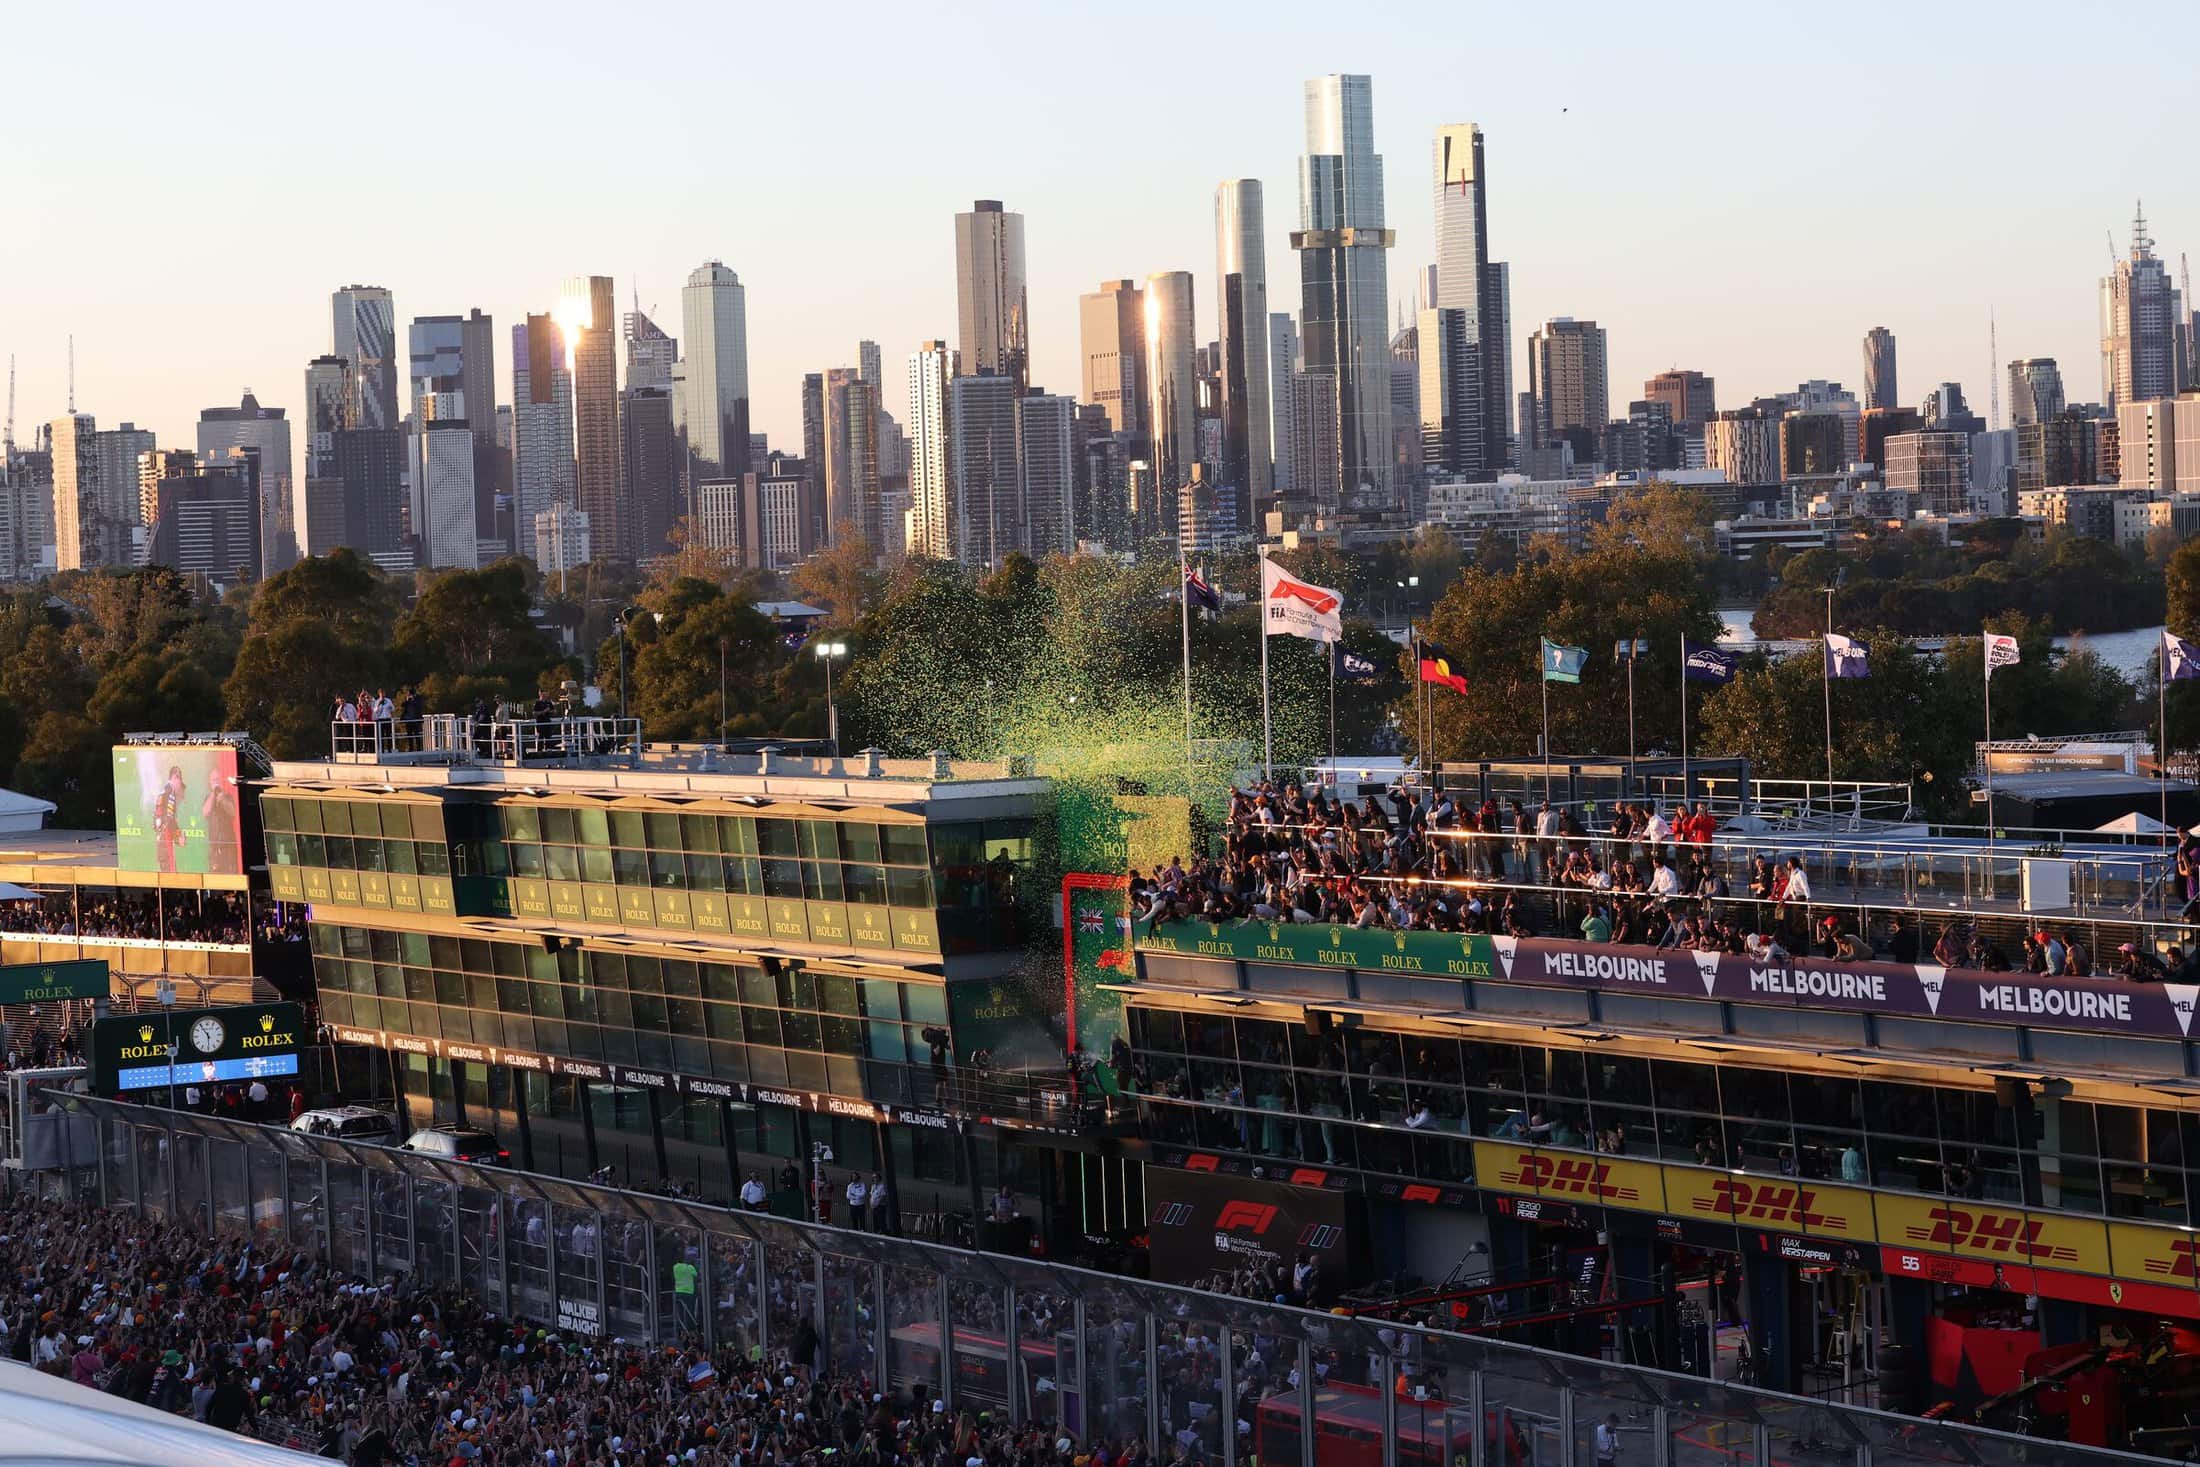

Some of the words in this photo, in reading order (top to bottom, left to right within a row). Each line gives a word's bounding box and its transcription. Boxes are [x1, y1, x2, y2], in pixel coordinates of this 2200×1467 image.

[1271, 607, 1286, 618] FIA
[522, 900, 546, 912] ROLEX
[556, 903, 579, 915] ROLEX
[590, 905, 614, 918] ROLEX
[625, 908, 650, 921] ROLEX
[661, 912, 687, 924] ROLEX
[698, 915, 724, 928] ROLEX
[736, 918, 763, 931] ROLEX
[775, 922, 802, 935] ROLEX
[815, 925, 843, 938] ROLEX
[856, 928, 885, 942] ROLEX
[901, 933, 930, 947] ROLEX
[1142, 935, 1177, 950] ROLEX
[1198, 940, 1234, 956] ROLEX
[1257, 945, 1295, 961] ROLEX
[1318, 950, 1358, 965] ROLEX
[1499, 948, 1516, 960] MEL
[1382, 954, 1423, 970] ROLEX
[1447, 960, 1490, 976] ROLEX
[1544, 951, 1667, 984] MELBOURNE
[1698, 964, 1717, 976] MEL
[1749, 967, 1886, 1001] MELBOURNE
[1921, 981, 1941, 993] MEL
[24, 986, 73, 1000] ROLEX
[1979, 984, 2132, 1021] MELBOURNE
[2172, 999, 2194, 1013] MEL
[975, 1007, 1021, 1019] ROLEX
[242, 1033, 294, 1048] ROLEX
[342, 1030, 375, 1044] MELBOURNE
[121, 1042, 172, 1059] ROLEX
[393, 1038, 427, 1052] MELBOURNE
[447, 1046, 483, 1061] MELBOURNE
[503, 1054, 541, 1068] MELBOURNE
[563, 1062, 602, 1078] MELBOURNE
[624, 1071, 665, 1087] MELBOURNE
[689, 1079, 732, 1097] MELBOURNE
[757, 1090, 802, 1107] MELBOURNE
[828, 1100, 874, 1117] MELBOURNE
[899, 1110, 948, 1128] MELBOURNE
[1517, 1154, 1621, 1199] DHL
[1517, 1200, 1541, 1211] SERGIO
[1712, 1179, 1825, 1227] DHL
[1517, 1209, 1539, 1219] PEREZ
[1928, 1208, 2054, 1257] DHL
[1215, 1235, 1229, 1248] FIA
[1240, 1239, 1257, 1248] Formula
[1781, 1238, 1800, 1247] MAX
[1781, 1247, 1831, 1261] VERSTAPPEN
[1902, 1256, 1919, 1271] 55
[559, 1300, 598, 1320] WALKER
[558, 1314, 600, 1336] STRAIGHT
